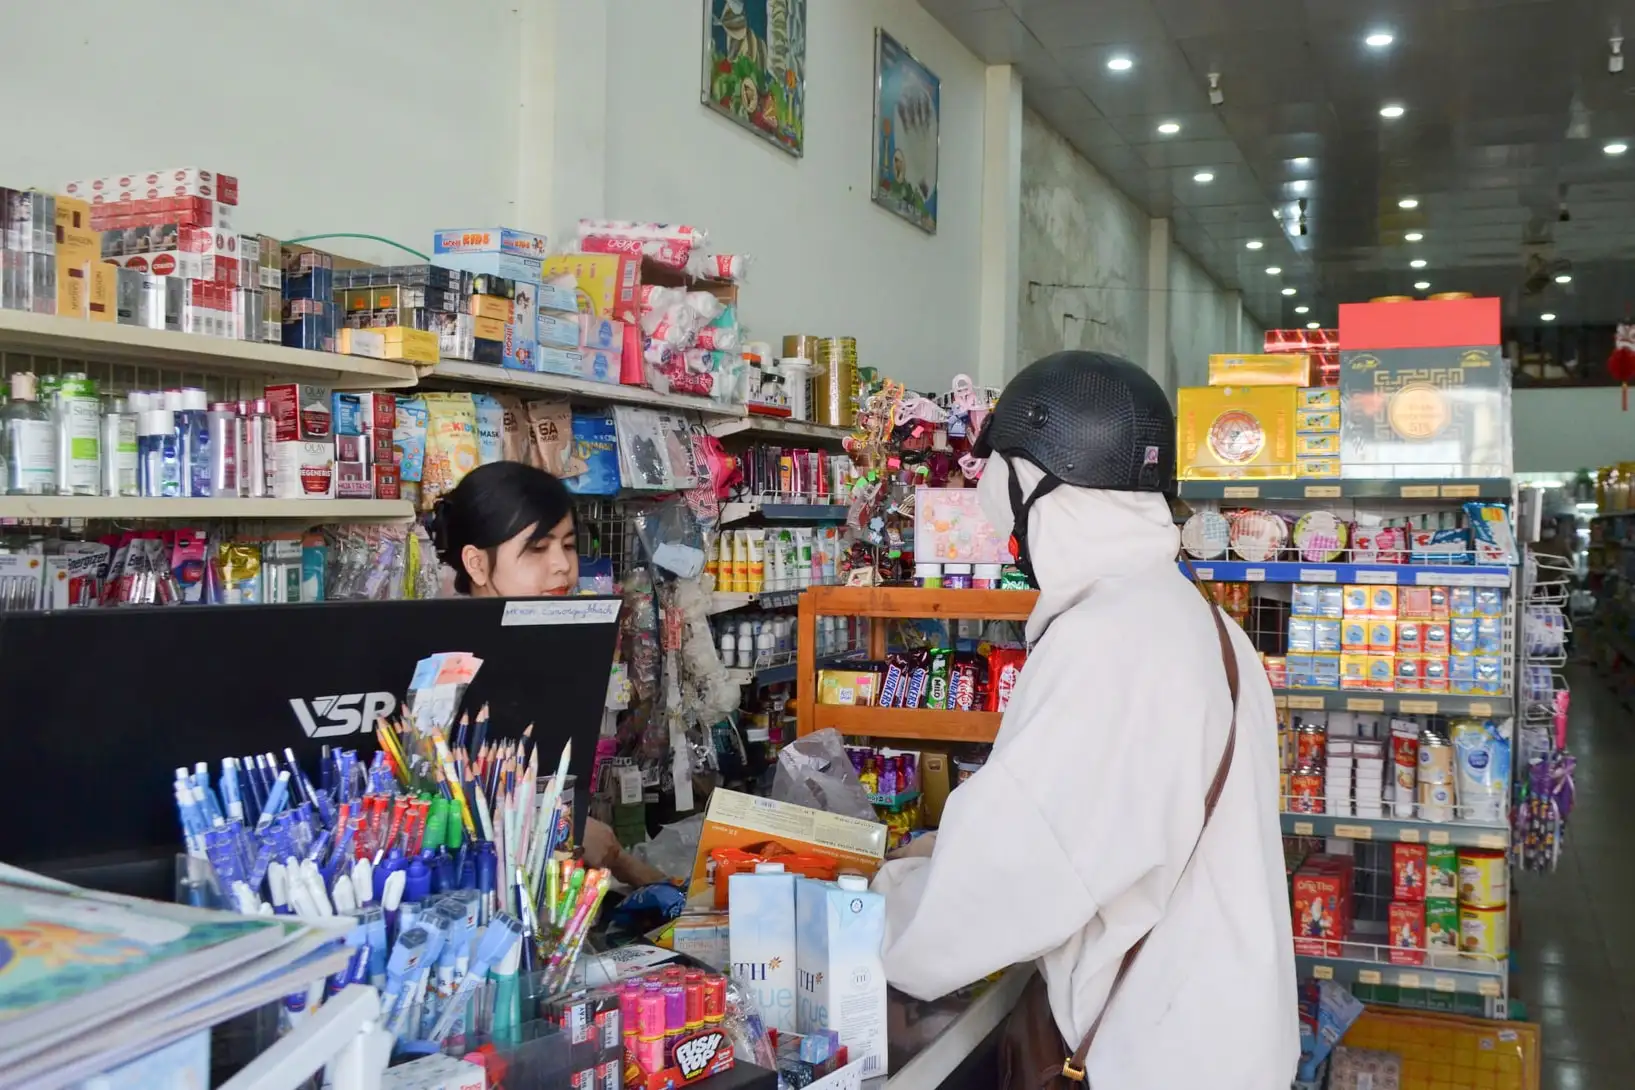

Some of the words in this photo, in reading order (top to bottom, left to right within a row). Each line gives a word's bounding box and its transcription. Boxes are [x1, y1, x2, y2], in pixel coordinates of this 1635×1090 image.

[305, 386, 325, 397] OLAY
[304, 443, 325, 454] OLAY
[67, 552, 108, 570] Energizer
[880, 665, 901, 708] SNICKERS
[907, 667, 924, 708] SNICKERS
[933, 678, 941, 699] MILO
[289, 692, 397, 738] VSR
[734, 962, 766, 980] TH
